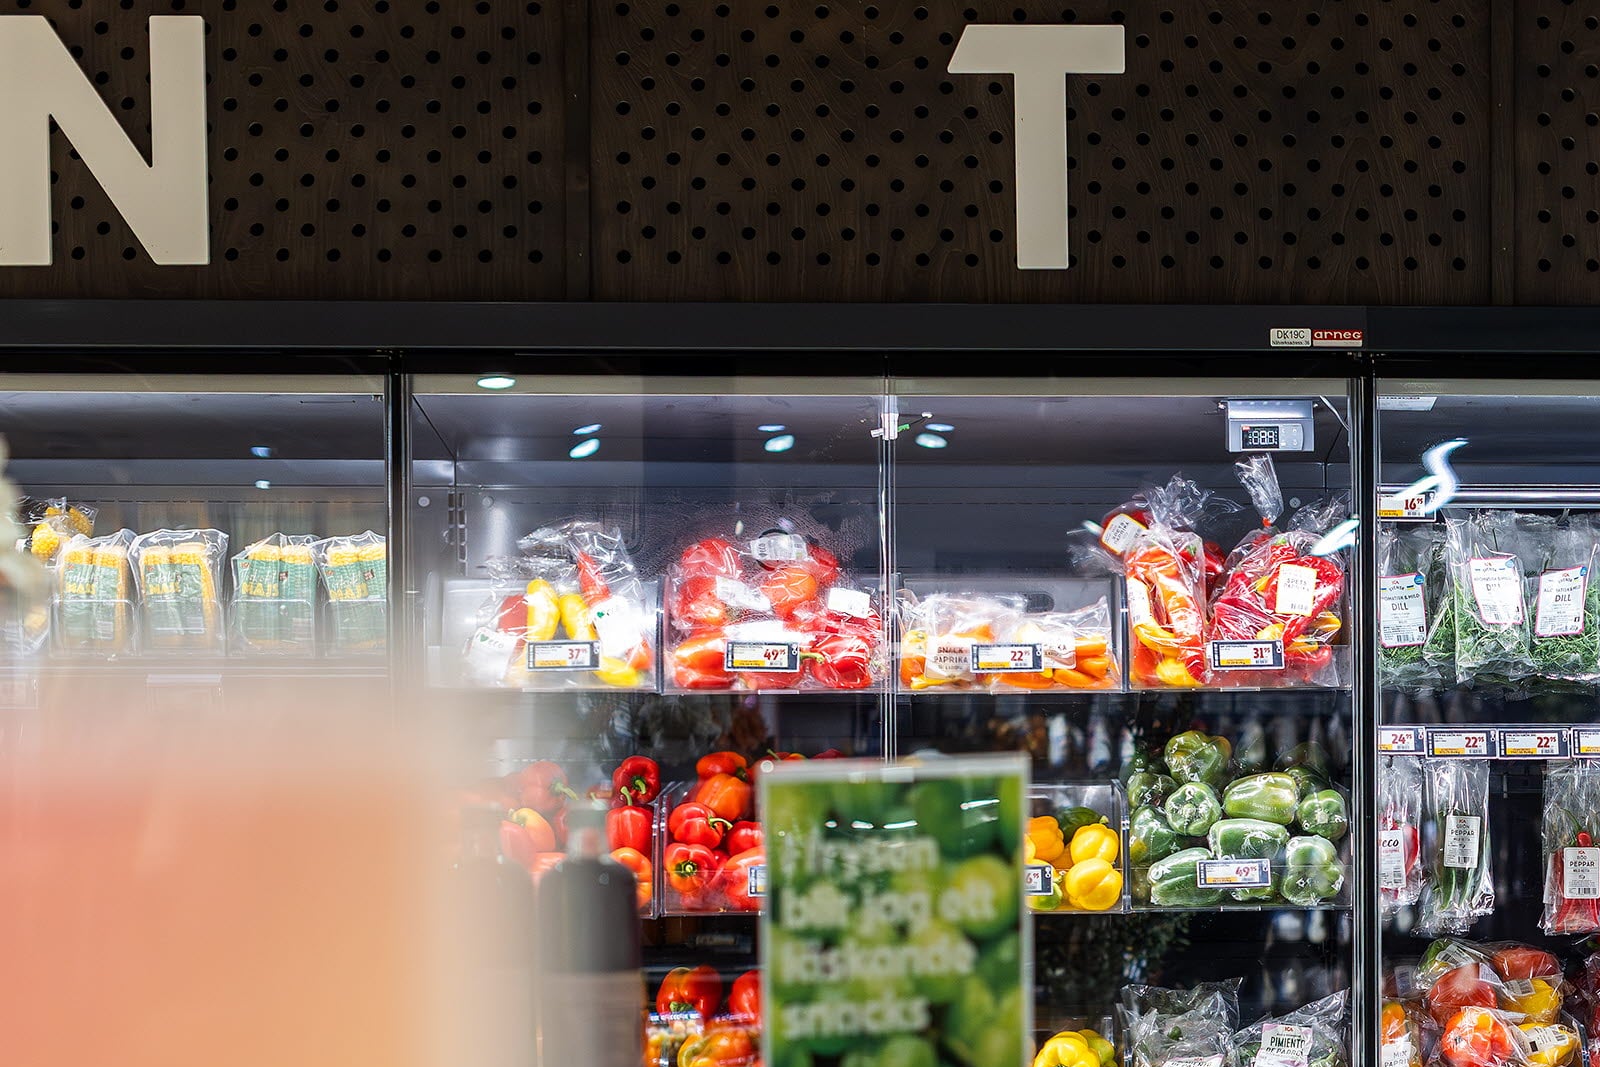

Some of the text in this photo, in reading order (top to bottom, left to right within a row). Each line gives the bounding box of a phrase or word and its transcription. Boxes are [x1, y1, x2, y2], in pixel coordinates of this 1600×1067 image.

[0, 15, 1126, 269] N T
[1276, 330, 1305, 339] DK19C
[1391, 602, 1409, 611] DILL
[1269, 1036, 1307, 1048] PIMIENTO
